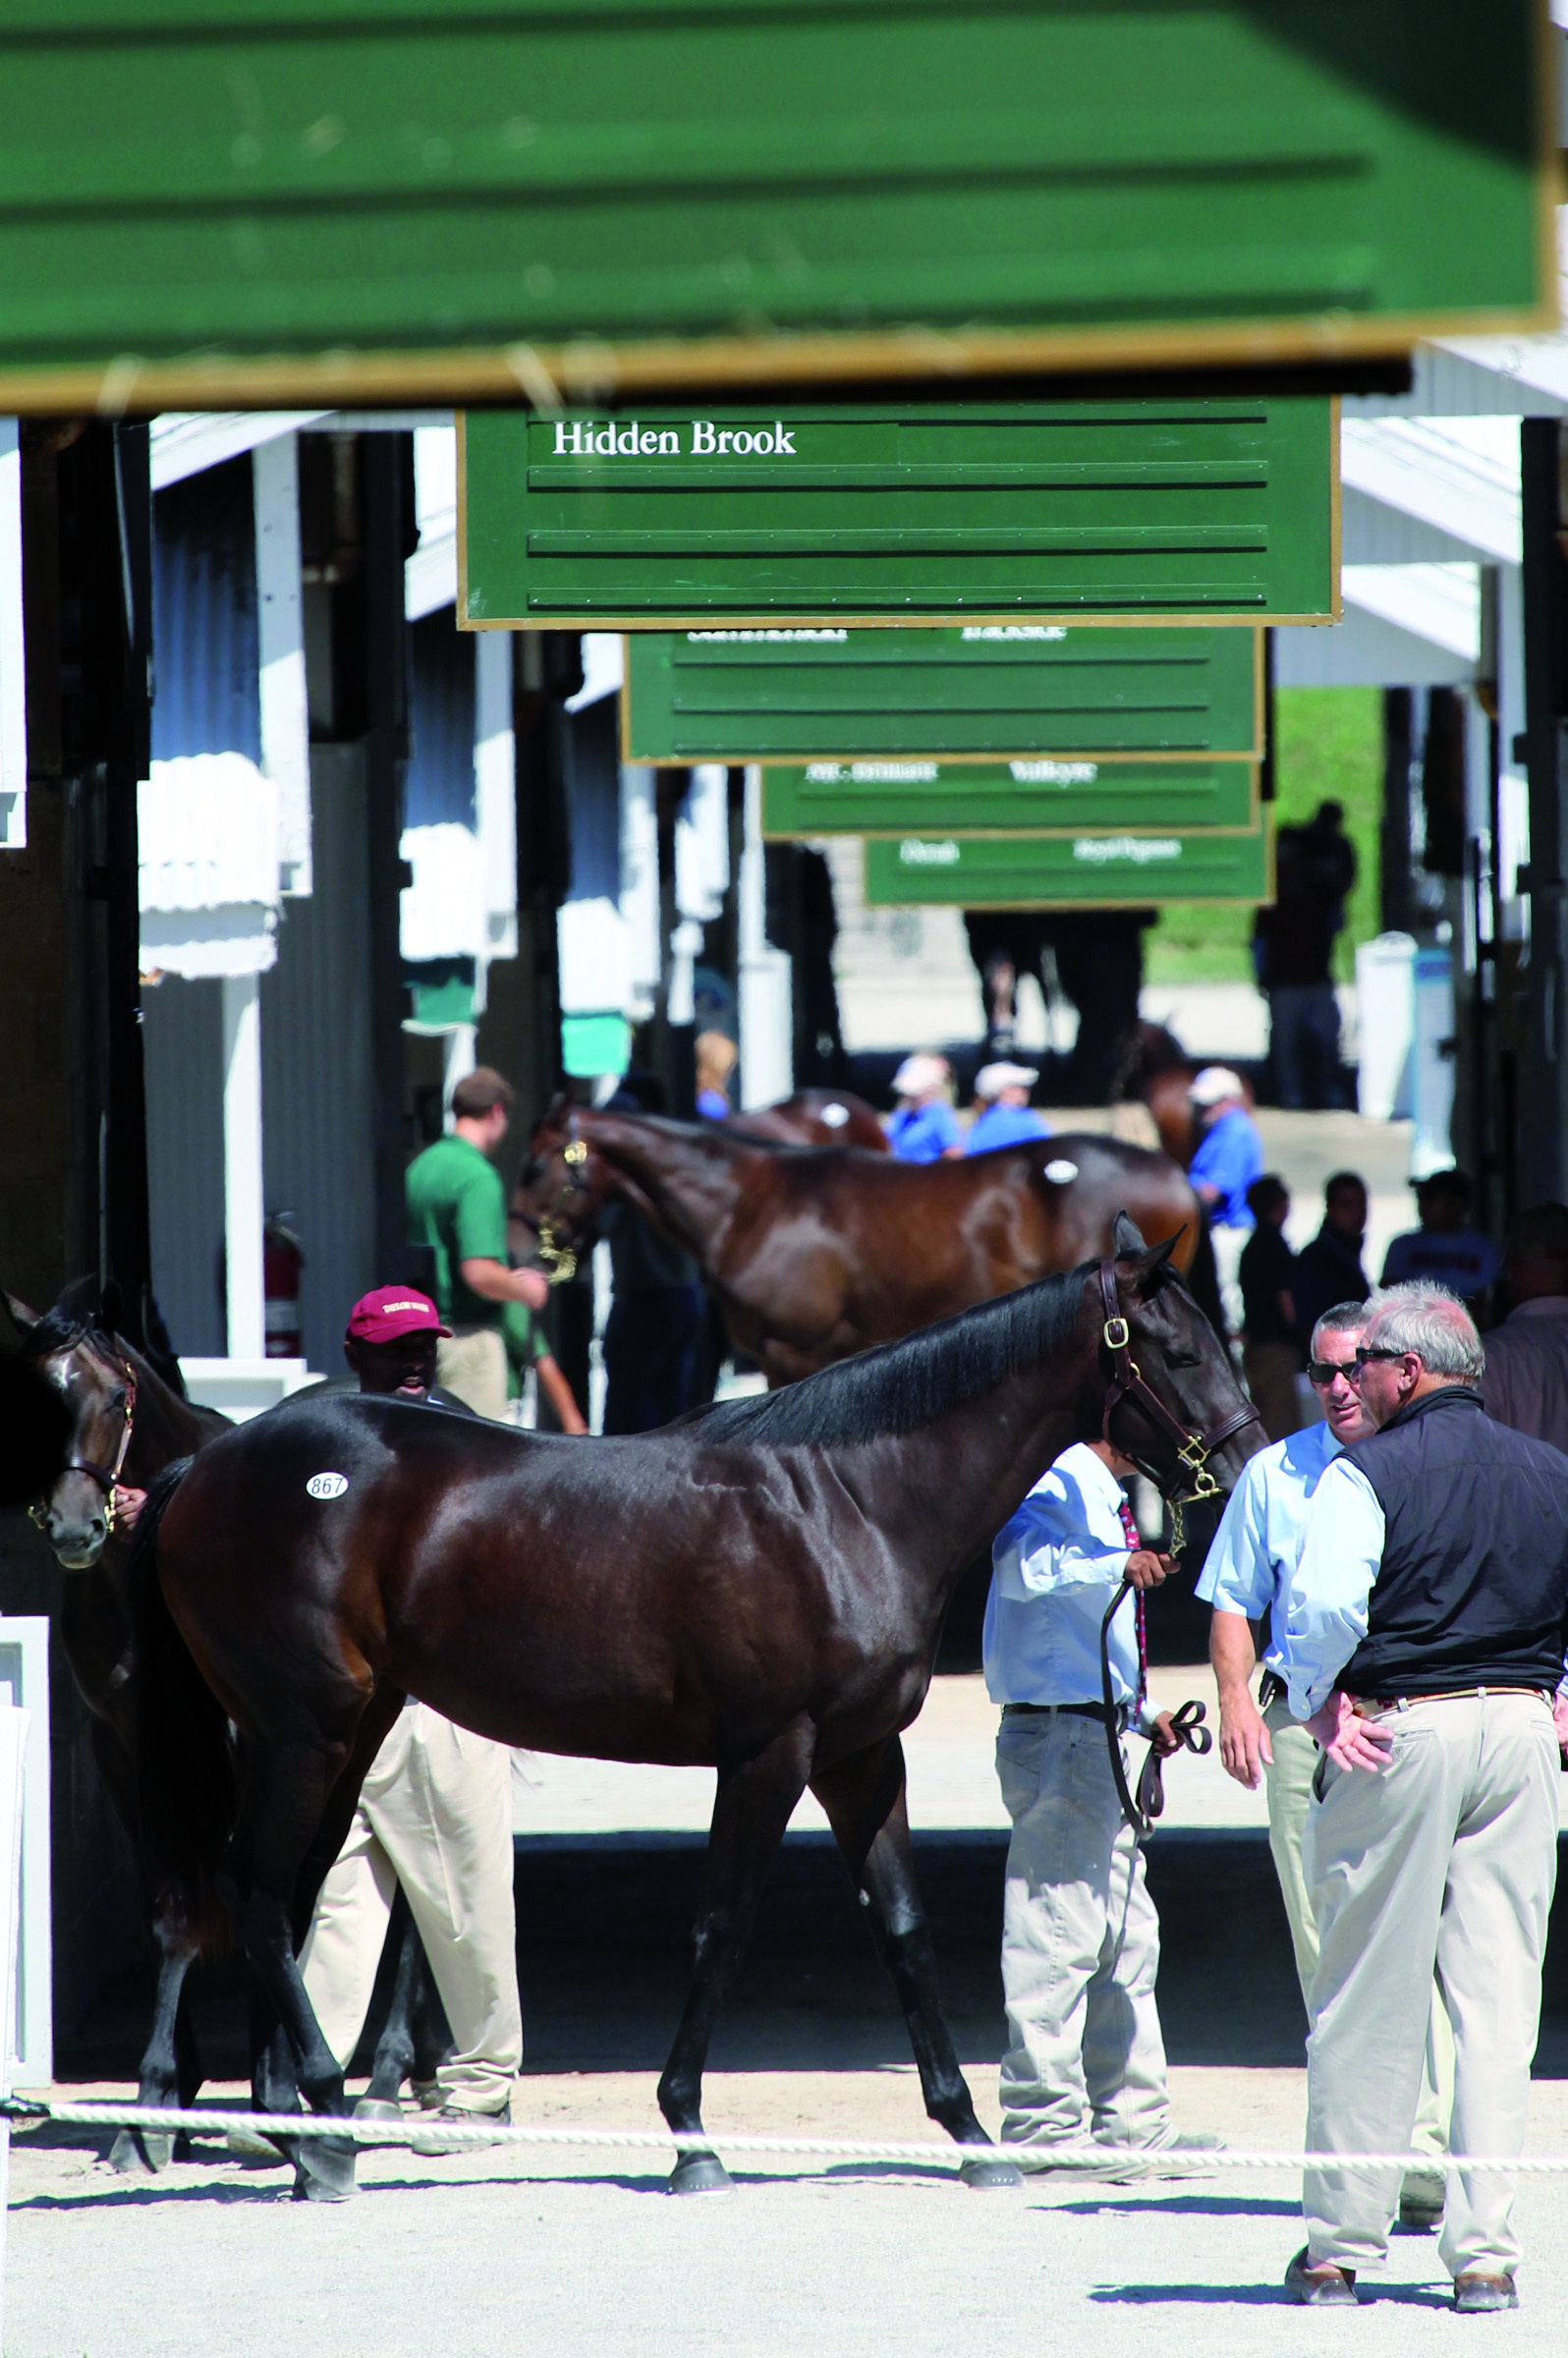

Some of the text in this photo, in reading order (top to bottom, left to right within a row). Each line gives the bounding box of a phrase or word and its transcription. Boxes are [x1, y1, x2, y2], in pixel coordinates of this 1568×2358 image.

[552, 421, 797, 455] Hidden Brook
[311, 1477, 344, 1494] 867
